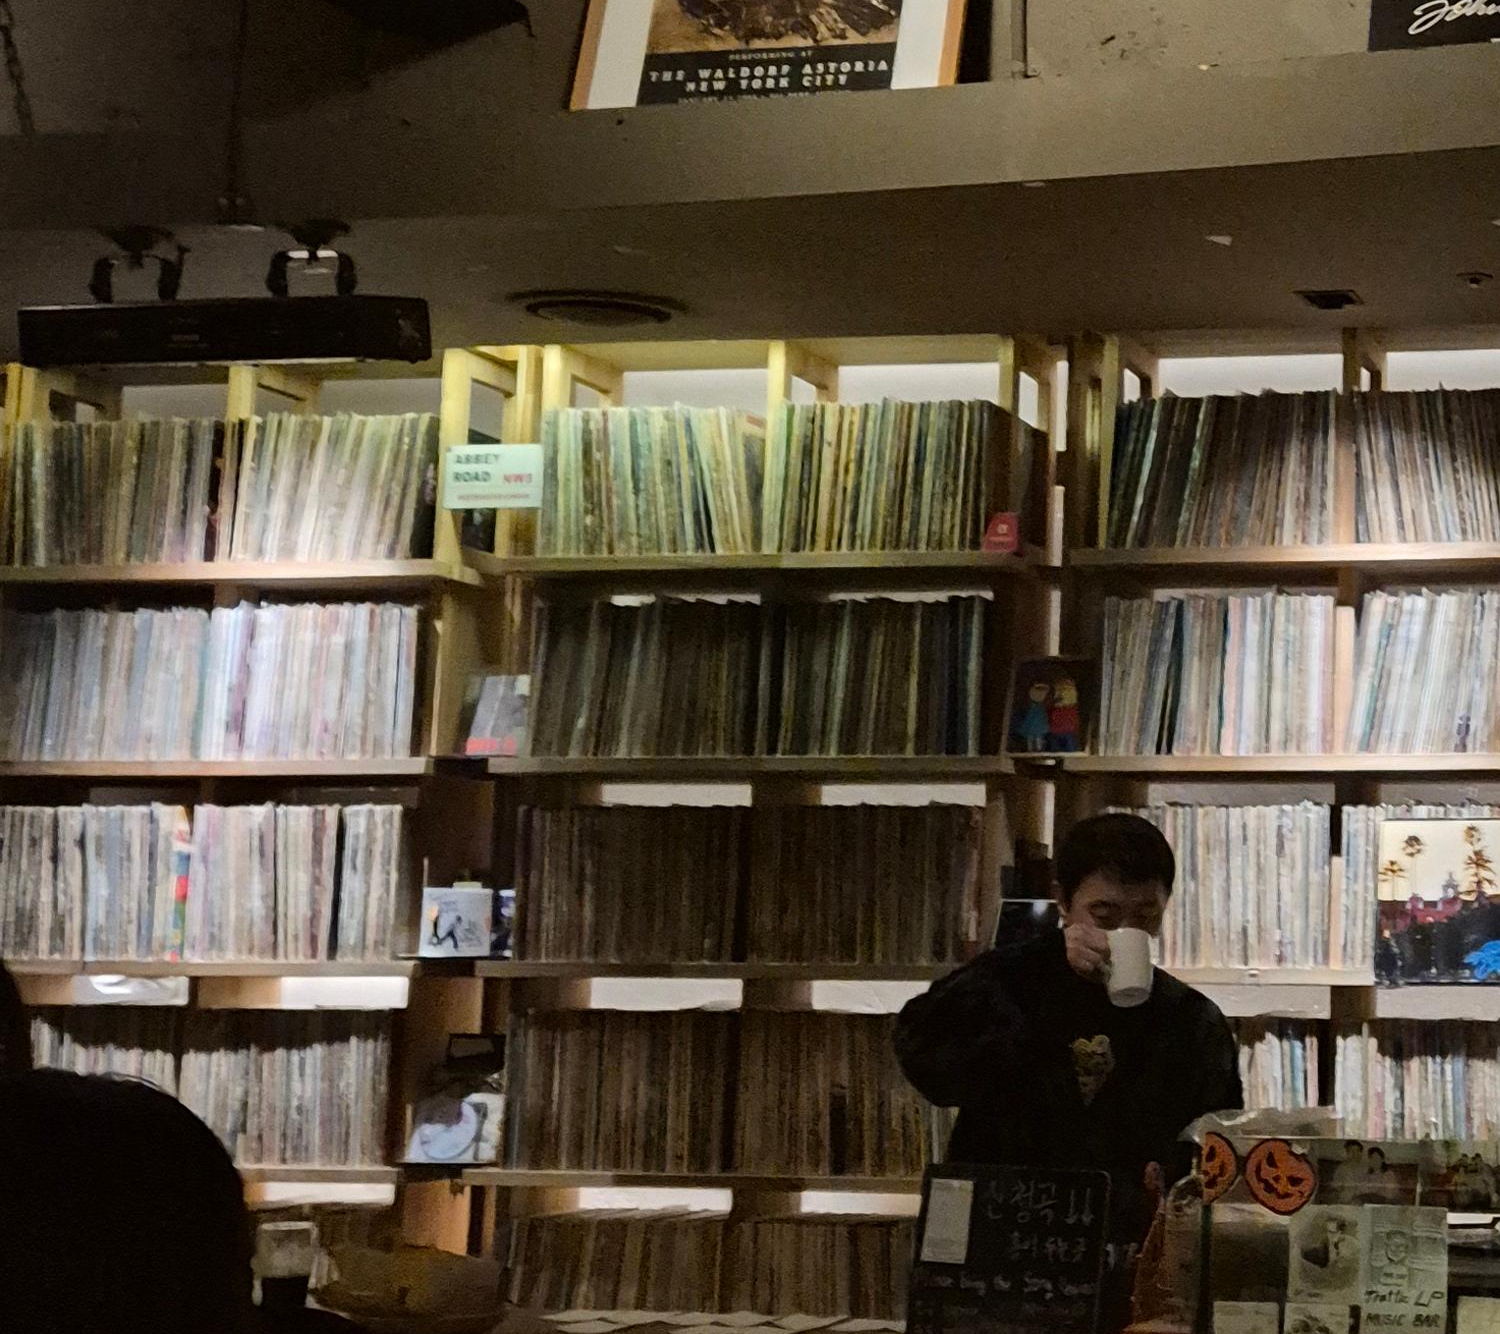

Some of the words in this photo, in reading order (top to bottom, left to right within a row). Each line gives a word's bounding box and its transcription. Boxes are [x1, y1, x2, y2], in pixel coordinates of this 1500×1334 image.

[650, 69, 686, 83] THE
[698, 64, 791, 80] WALDORF
[801, 59, 889, 75] ASTORIA
[685, 79, 727, 93] NEW
[739, 77, 789, 90] YORK
[802, 74, 848, 87] CITY
[453, 470, 492, 483] ROAD
